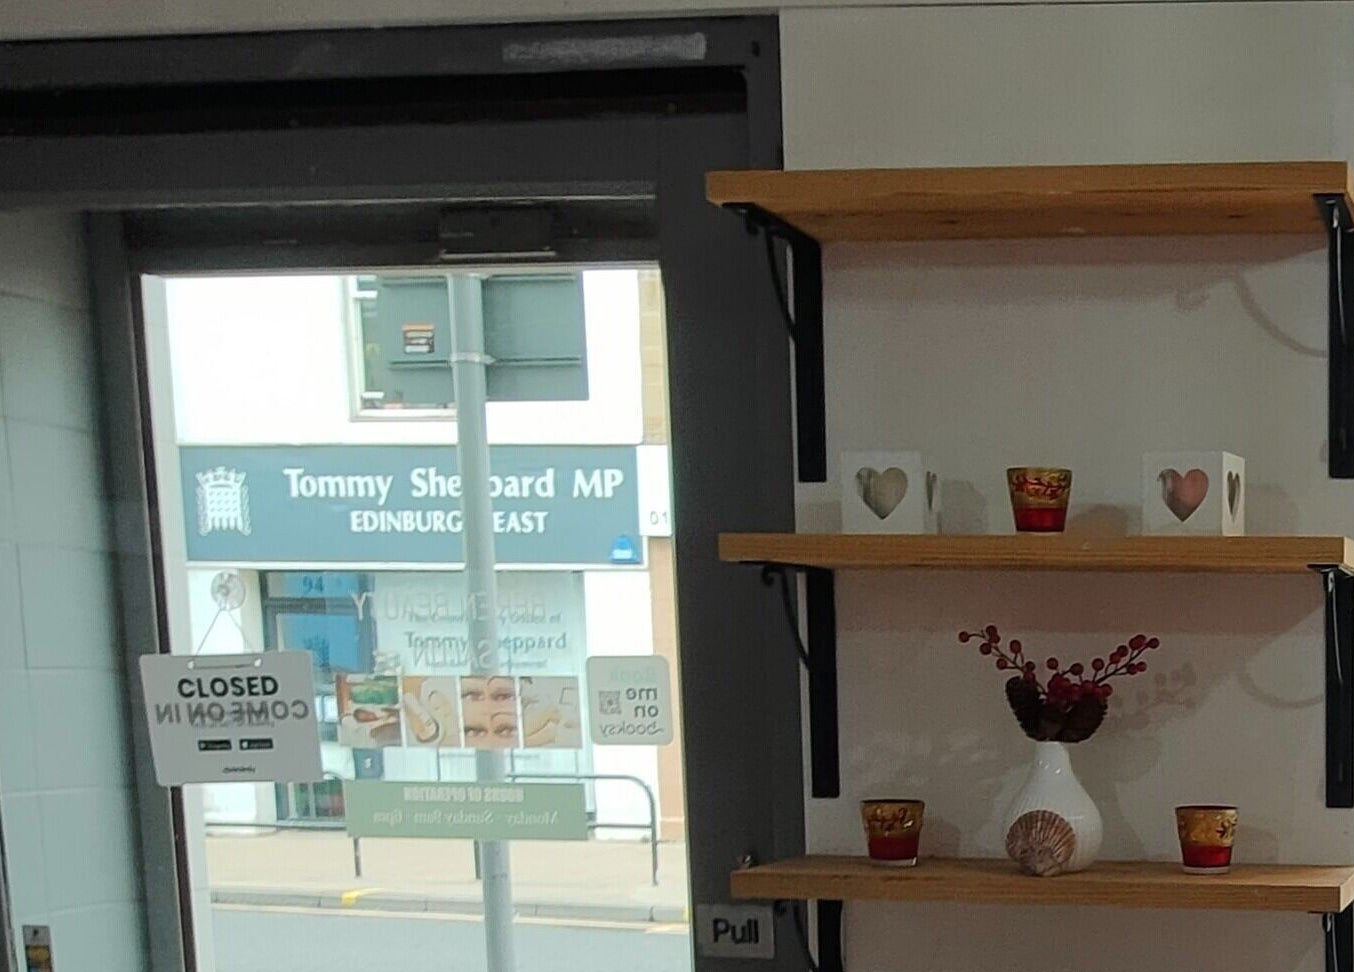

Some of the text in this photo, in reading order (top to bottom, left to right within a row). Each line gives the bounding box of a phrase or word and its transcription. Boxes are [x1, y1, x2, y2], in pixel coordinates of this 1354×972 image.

[282, 467, 624, 505] Tommy Sheard MP
[350, 510, 547, 534] EDINBURG EAST
[490, 631, 567, 655] eppard
[177, 676, 279, 698] CLOSED
[713, 918, 759, 944] Pull
